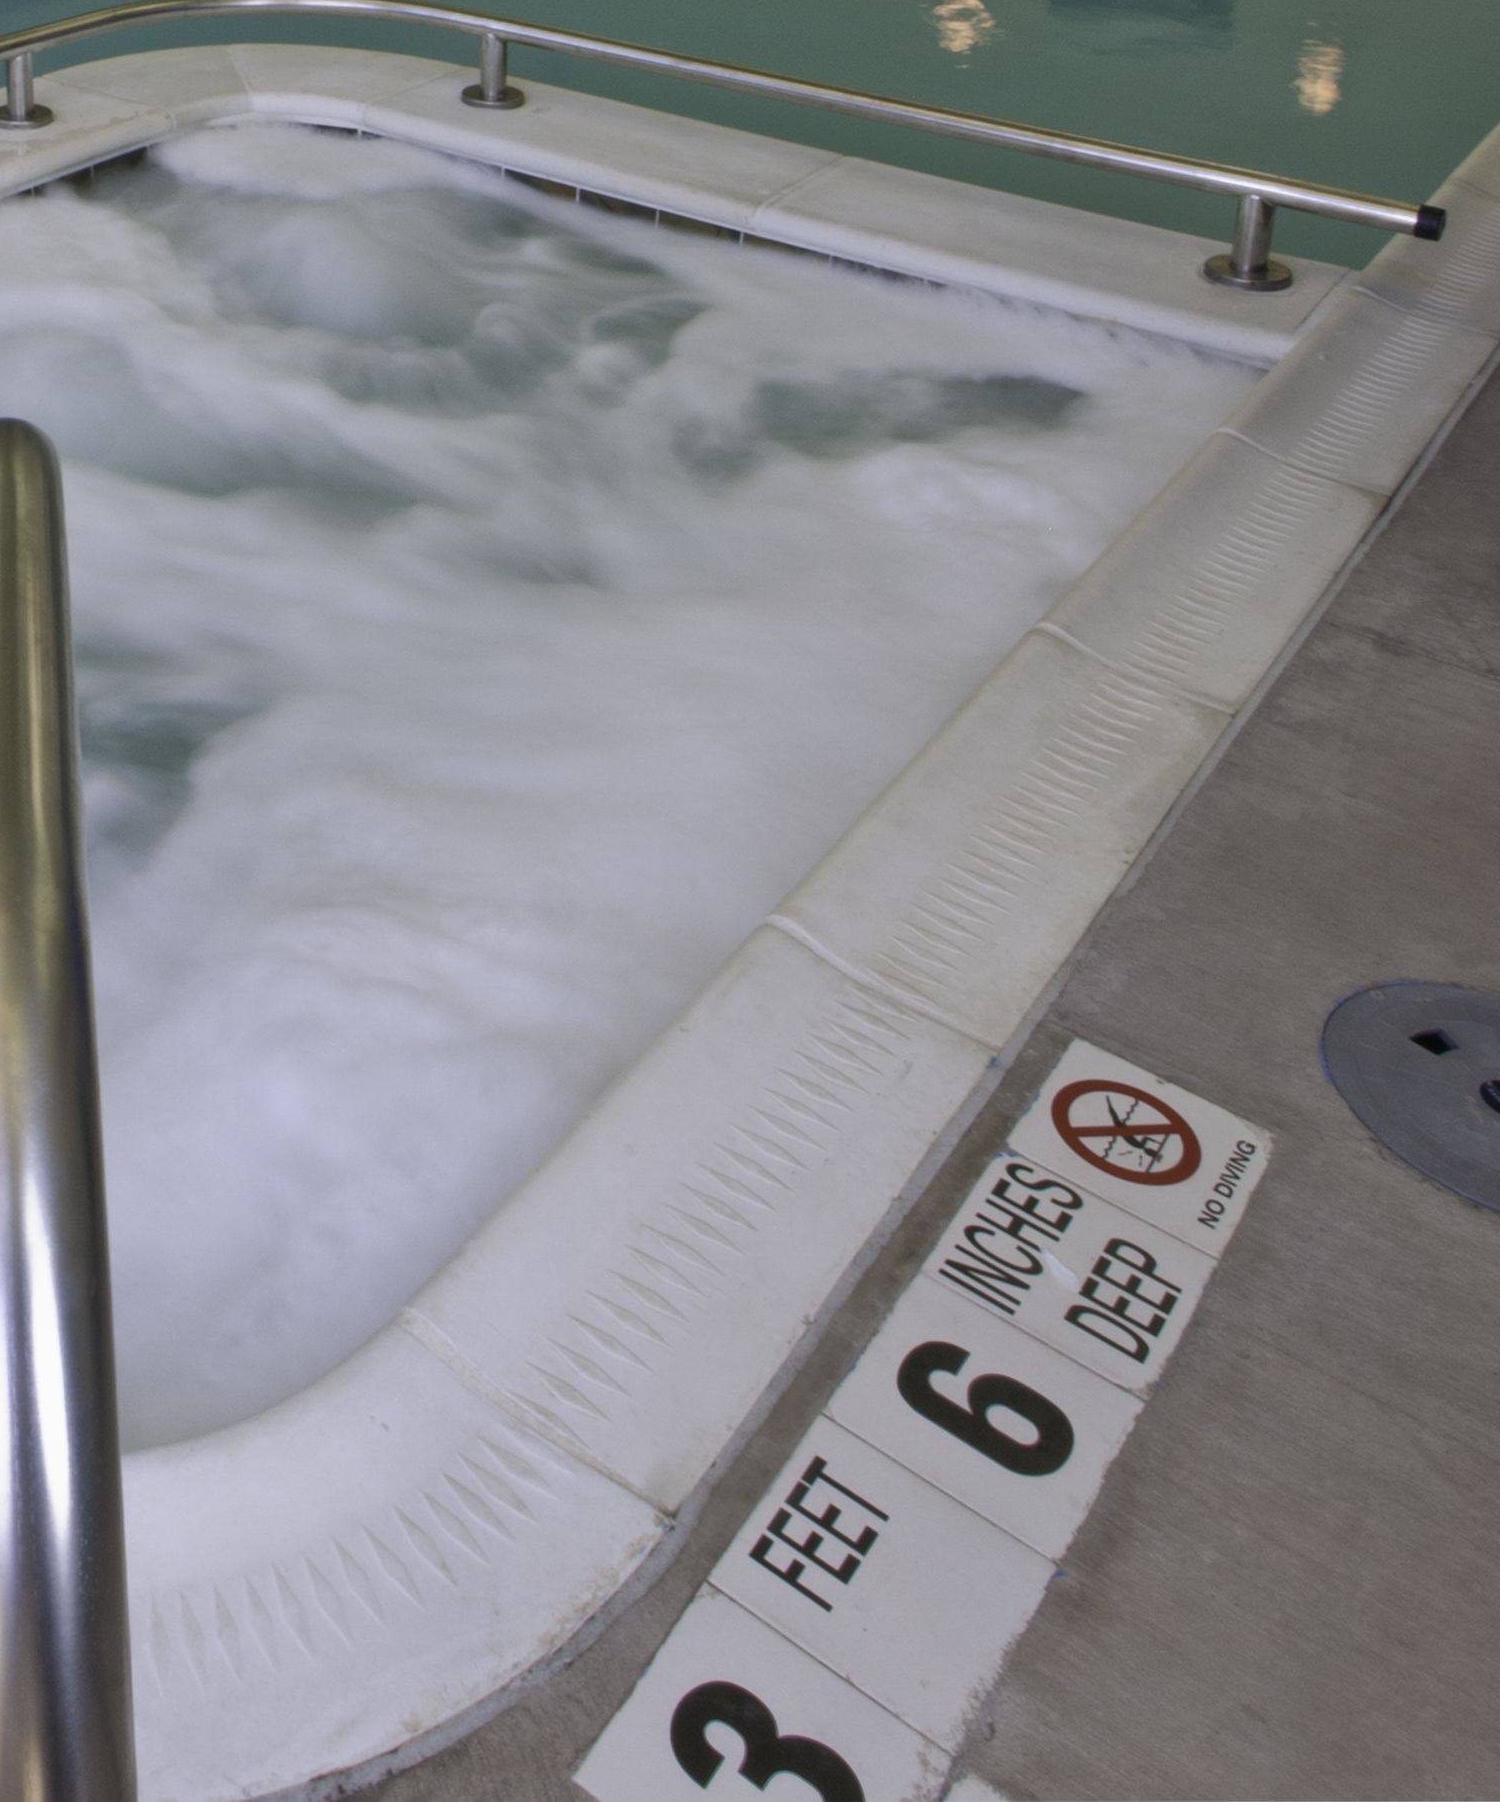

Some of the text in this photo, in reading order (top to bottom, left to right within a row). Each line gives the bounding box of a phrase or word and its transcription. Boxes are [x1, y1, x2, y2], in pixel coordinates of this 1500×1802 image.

[937, 1162, 1085, 1315] INCHES
[1196, 1139, 1257, 1229] NO DIVING
[1064, 1237, 1183, 1365] DEEP
[896, 1340, 1076, 1478] 6
[748, 1455, 890, 1612] FEET
[669, 1680, 865, 1802] 3
